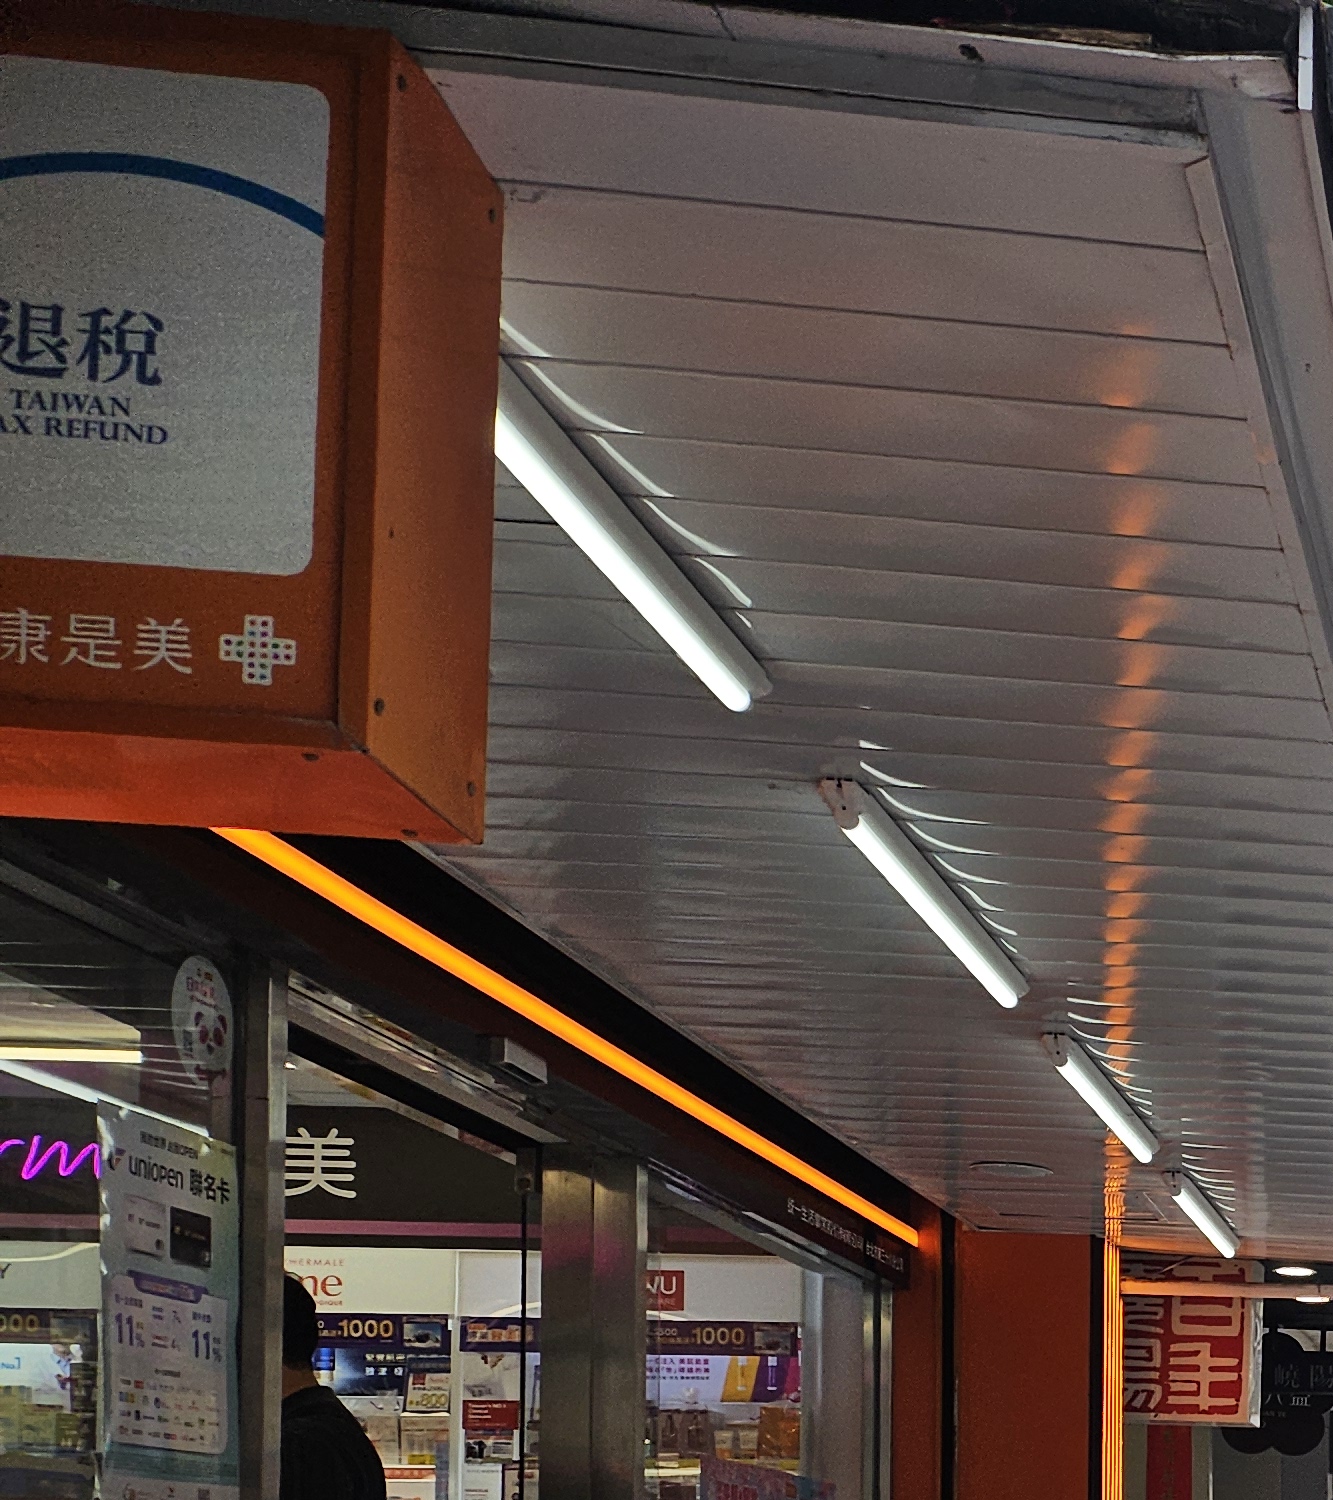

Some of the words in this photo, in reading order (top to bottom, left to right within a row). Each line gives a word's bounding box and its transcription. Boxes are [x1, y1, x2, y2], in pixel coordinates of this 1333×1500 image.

[9, 387, 131, 419] TAIWAN
[43, 416, 168, 446] REFUND
[285, 1127, 358, 1199] 美
[189, 1168, 231, 1205] 聯名卡
